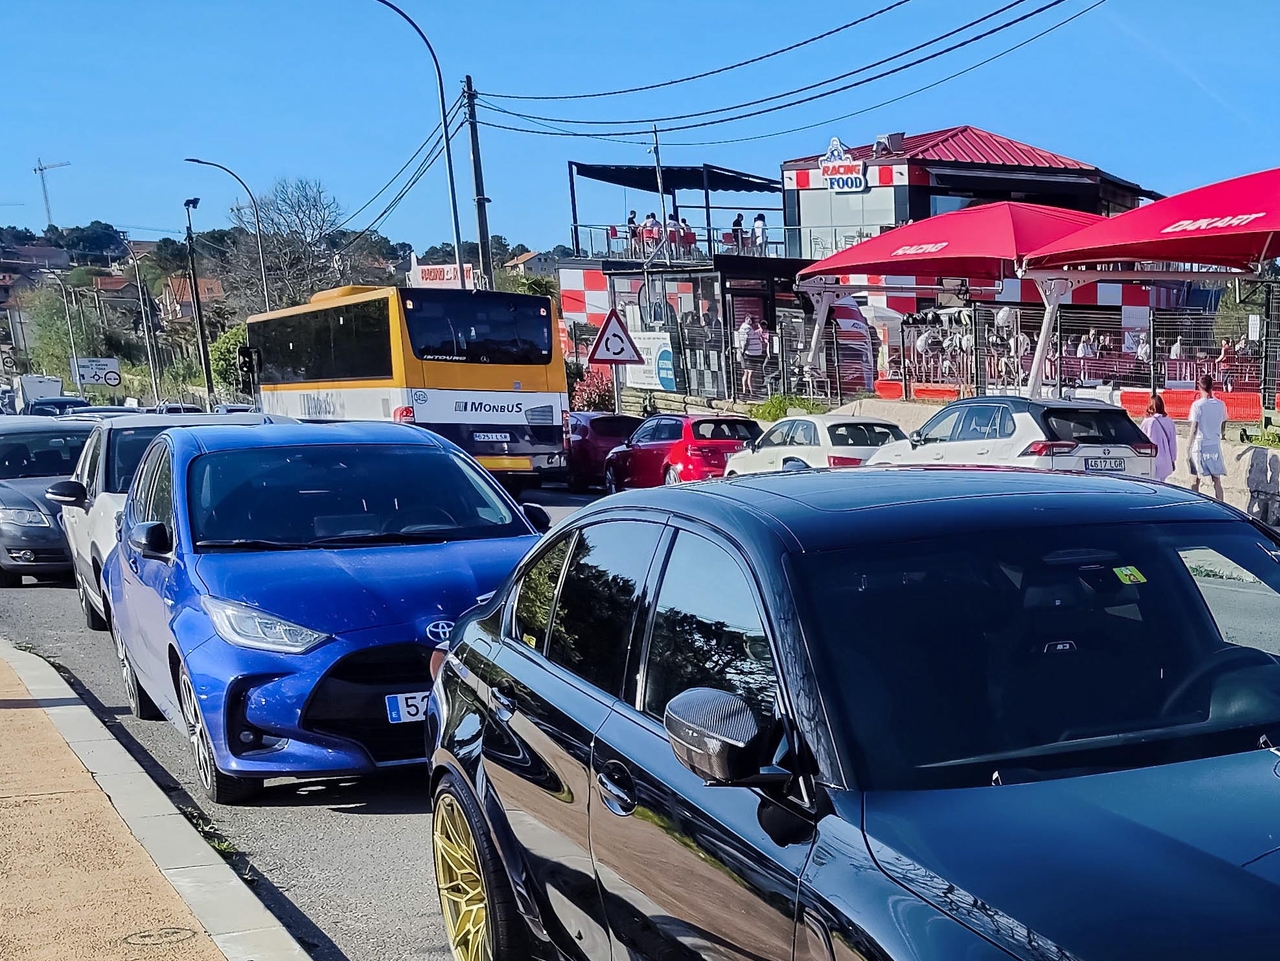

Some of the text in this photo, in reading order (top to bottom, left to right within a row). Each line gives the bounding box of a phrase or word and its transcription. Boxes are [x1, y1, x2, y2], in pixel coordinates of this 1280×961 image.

[822, 164, 861, 177] RACING
[828, 177, 863, 190] FOOD
[1089, 459, 1108, 469] 4617
